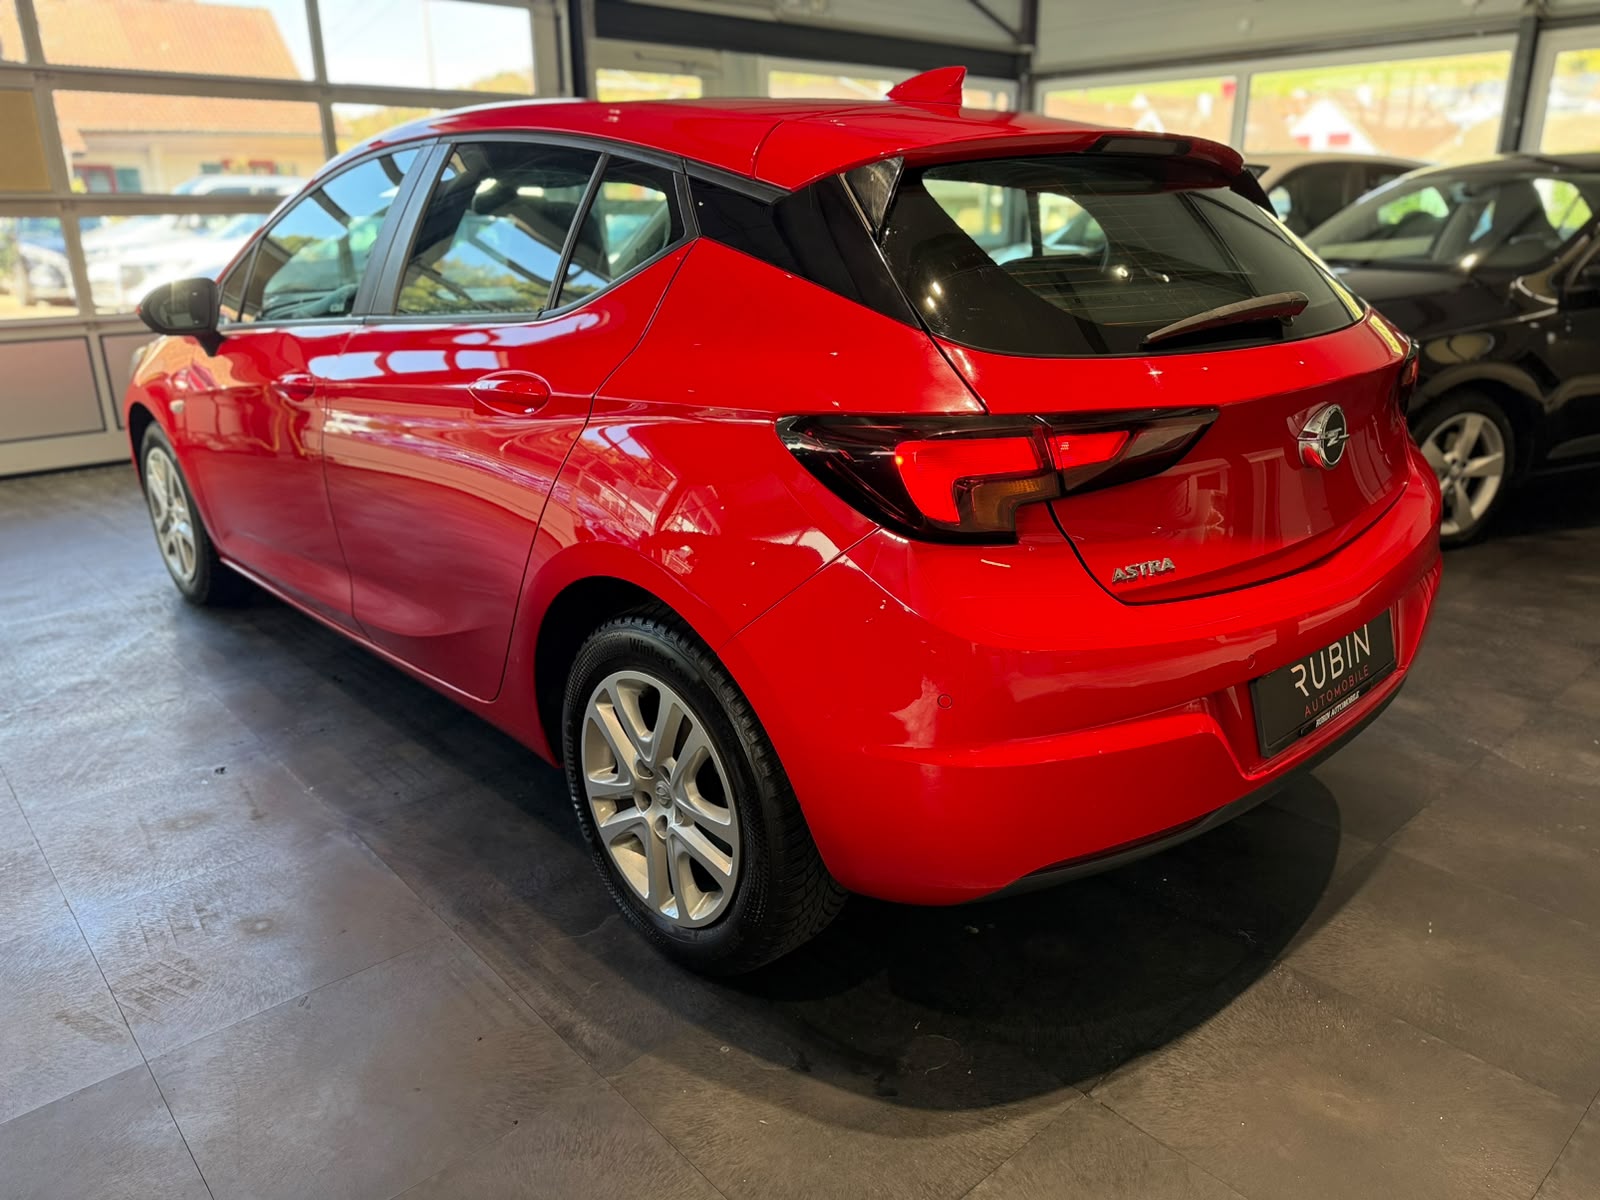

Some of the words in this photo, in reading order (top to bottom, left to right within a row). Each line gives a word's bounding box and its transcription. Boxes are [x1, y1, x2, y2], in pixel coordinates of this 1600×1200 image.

[1112, 558, 1175, 583] ASTRA
[1290, 624, 1371, 697] RUBIN
[1304, 664, 1370, 718] AUTOMOBILE
